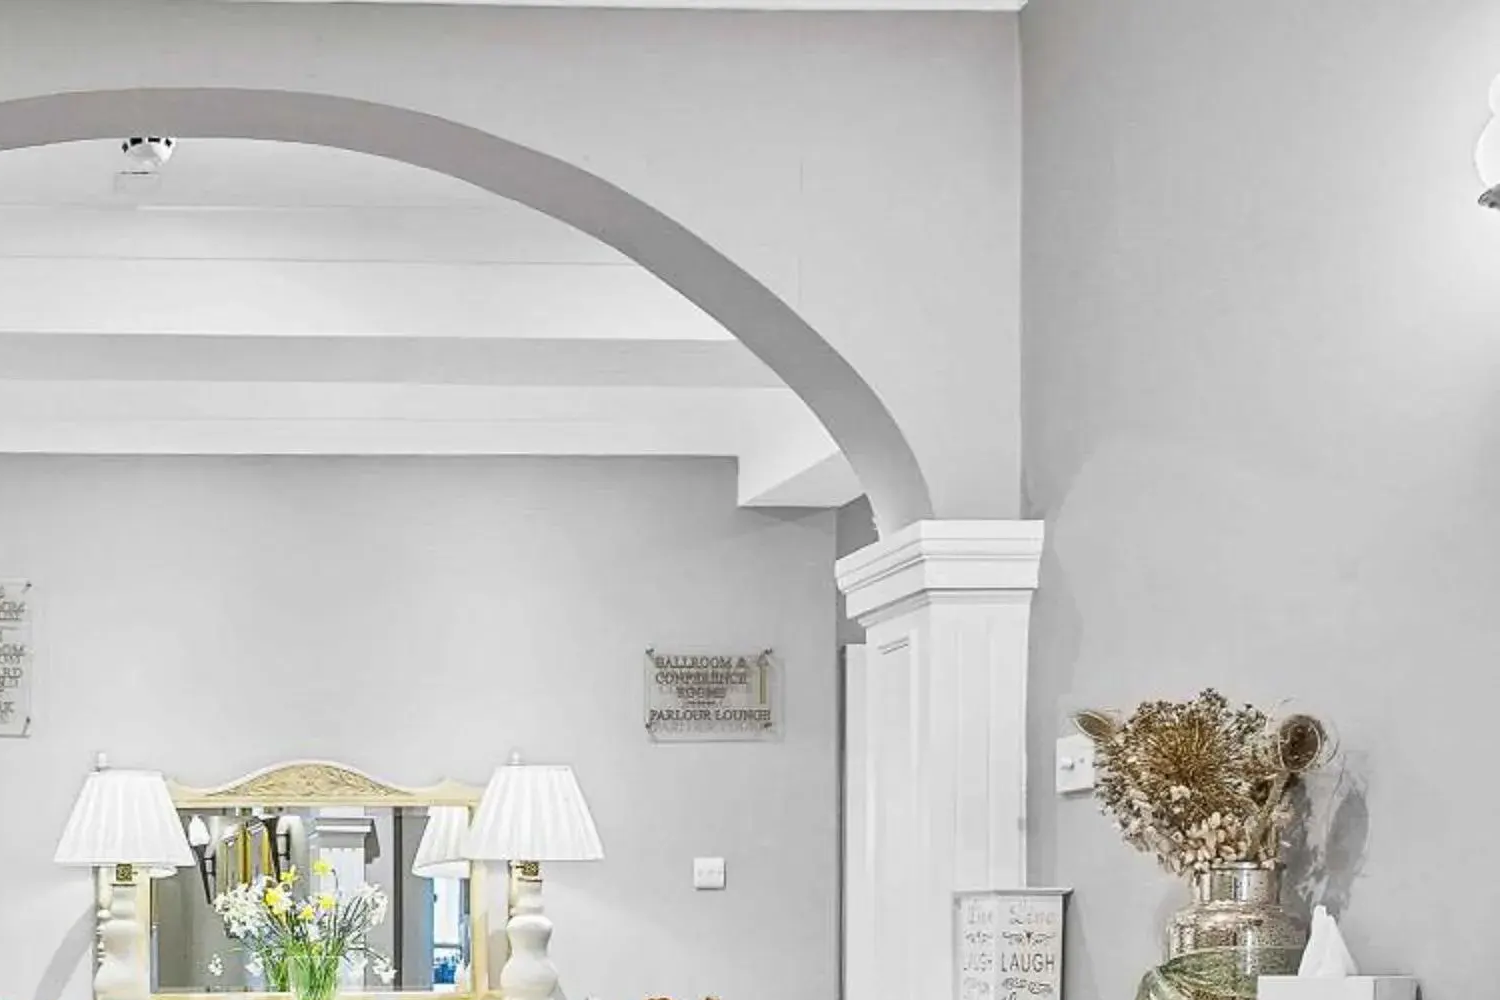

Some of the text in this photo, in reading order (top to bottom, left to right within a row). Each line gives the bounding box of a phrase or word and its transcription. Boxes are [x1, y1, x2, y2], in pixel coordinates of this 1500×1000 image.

[655, 656, 749, 669] BALLROOM &
[655, 672, 749, 685] CONFERENCE
[676, 687, 726, 699] ROOMS
[649, 709, 771, 721] PARLOUR LOUNGE
[1001, 952, 1055, 974] LAUGH
